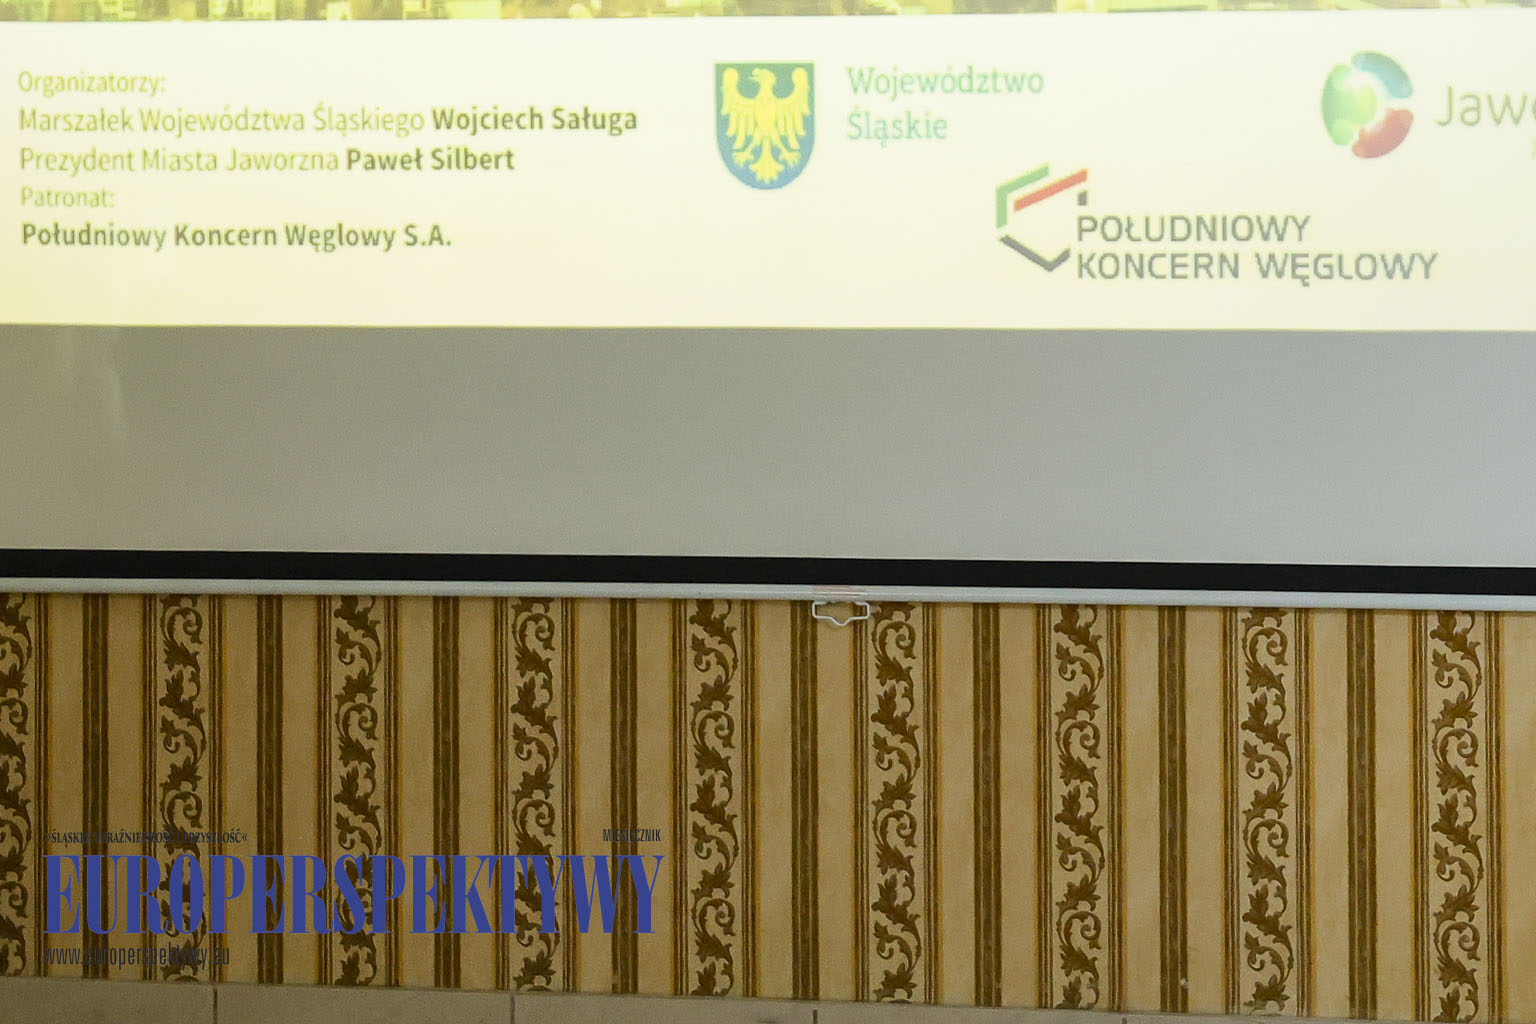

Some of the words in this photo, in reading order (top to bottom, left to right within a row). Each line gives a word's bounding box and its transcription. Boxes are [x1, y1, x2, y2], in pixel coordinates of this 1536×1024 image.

[18, 70, 167, 98] Organizatorzy:
[845, 65, 1045, 102] Województwo
[19, 107, 134, 132] Marszałek
[140, 104, 306, 138] Województwa
[313, 101, 425, 138] Śląskiego
[432, 105, 544, 136] Wojciech
[551, 106, 638, 137] Saługa
[846, 107, 949, 148] Śląskie
[20, 147, 136, 178] Prezydent
[141, 147, 219, 171] Miasta
[225, 148, 339, 171] Jaworzna
[346, 147, 423, 171] Paweł
[430, 146, 515, 171] Silbert
[21, 186, 116, 208] Patronat:
[22, 222, 166, 252] Południowy
[174, 223, 277, 247] Koncern
[284, 222, 396, 253] Węglowy
[404, 223, 452, 248] S.A.
[1076, 214, 1311, 243] POŁUDNIOWY
[1076, 252, 1241, 280] KONCERN
[1254, 252, 1439, 288] WĘGLOWY
